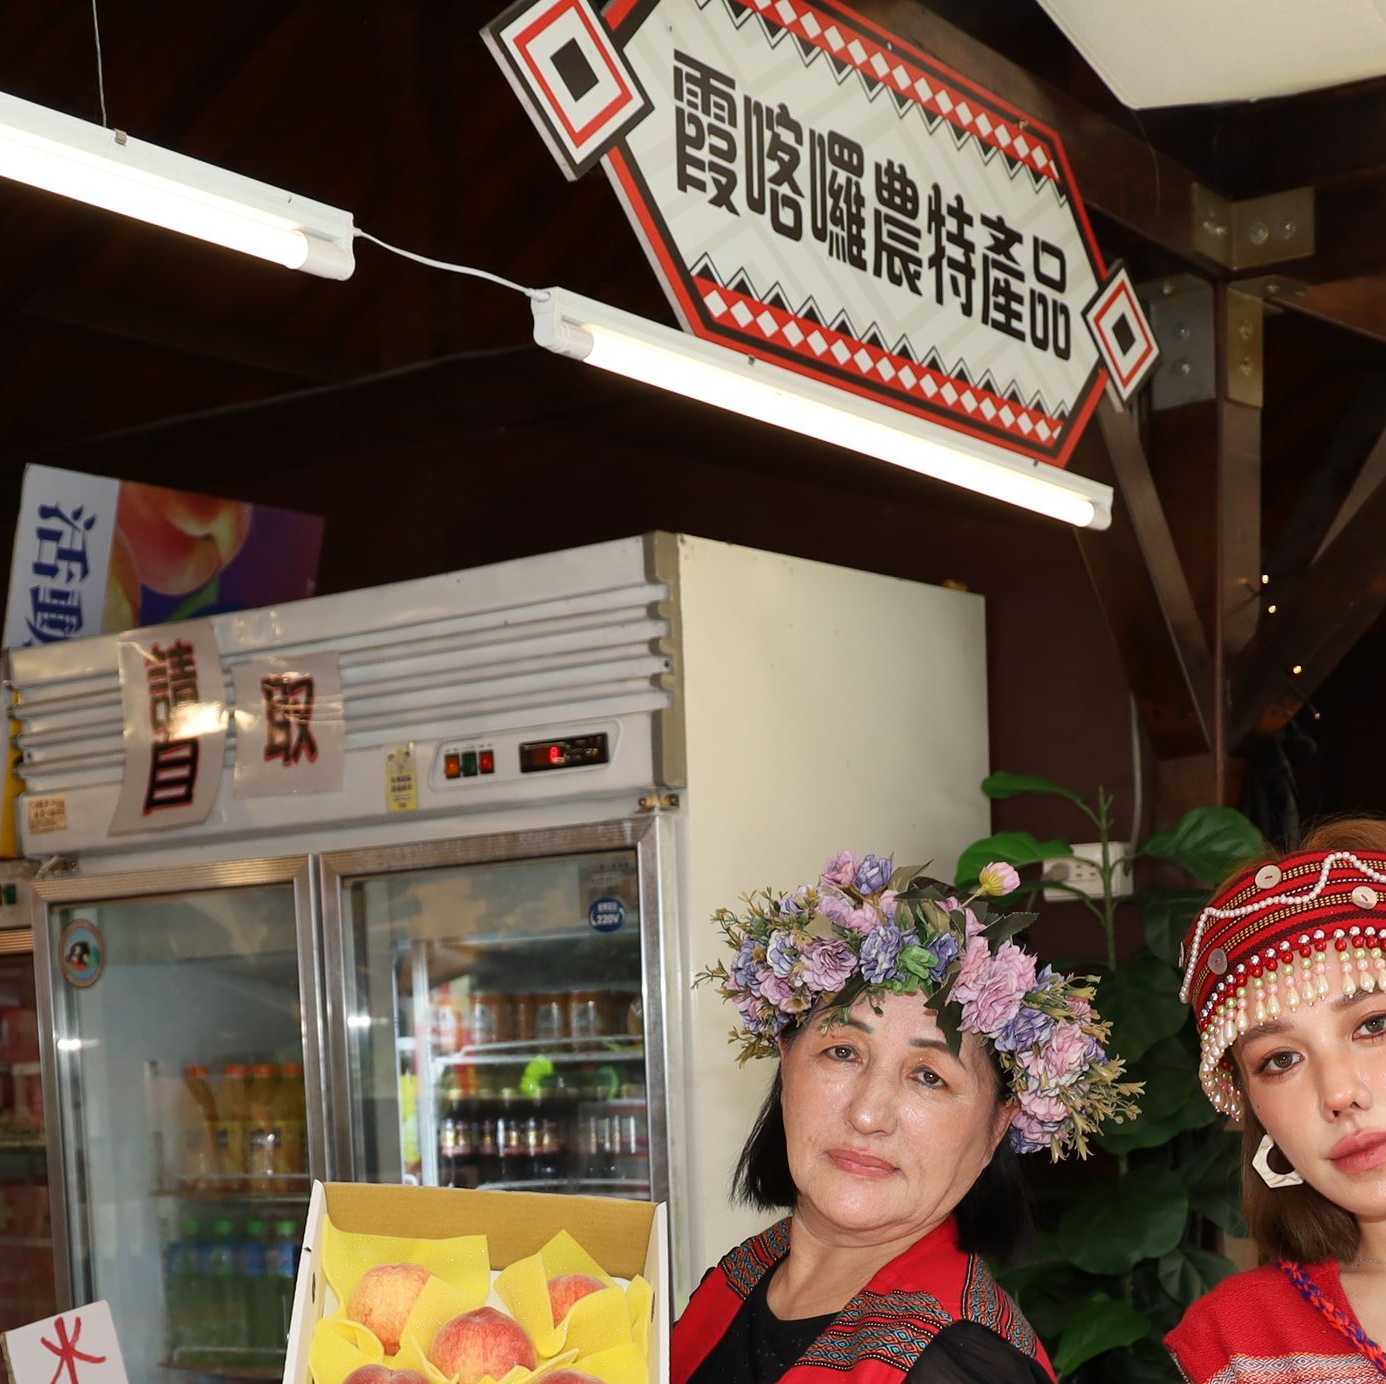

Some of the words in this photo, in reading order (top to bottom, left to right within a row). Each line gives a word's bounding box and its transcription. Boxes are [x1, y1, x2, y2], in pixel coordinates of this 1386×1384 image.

[671, 49, 1073, 362] 霞喀囉農特產品
